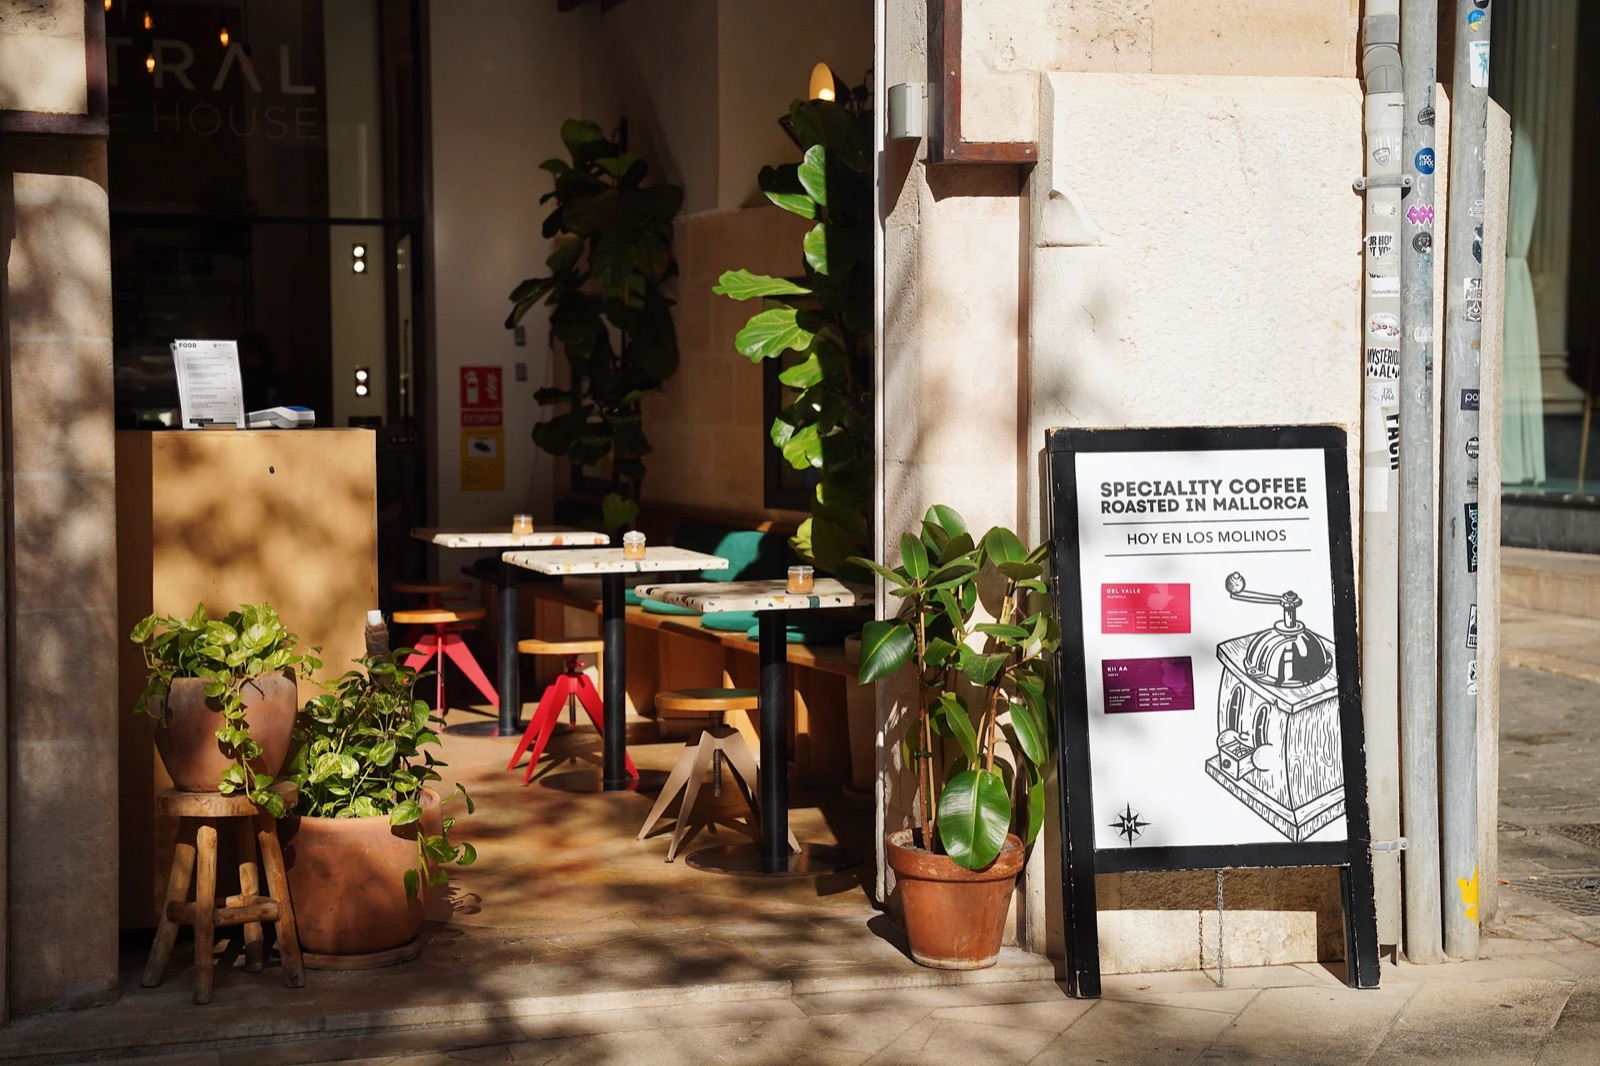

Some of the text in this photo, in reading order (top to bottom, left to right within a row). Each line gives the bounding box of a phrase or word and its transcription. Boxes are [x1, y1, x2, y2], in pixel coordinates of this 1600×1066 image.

[153, 101, 320, 140] HOUSE
[1100, 477, 1307, 497] SPECIALITY COFFEE
[1101, 496, 1309, 514] ROASTED IN MALLORCA
[1126, 529, 1287, 545] HOY EN LOS MOLINOS
